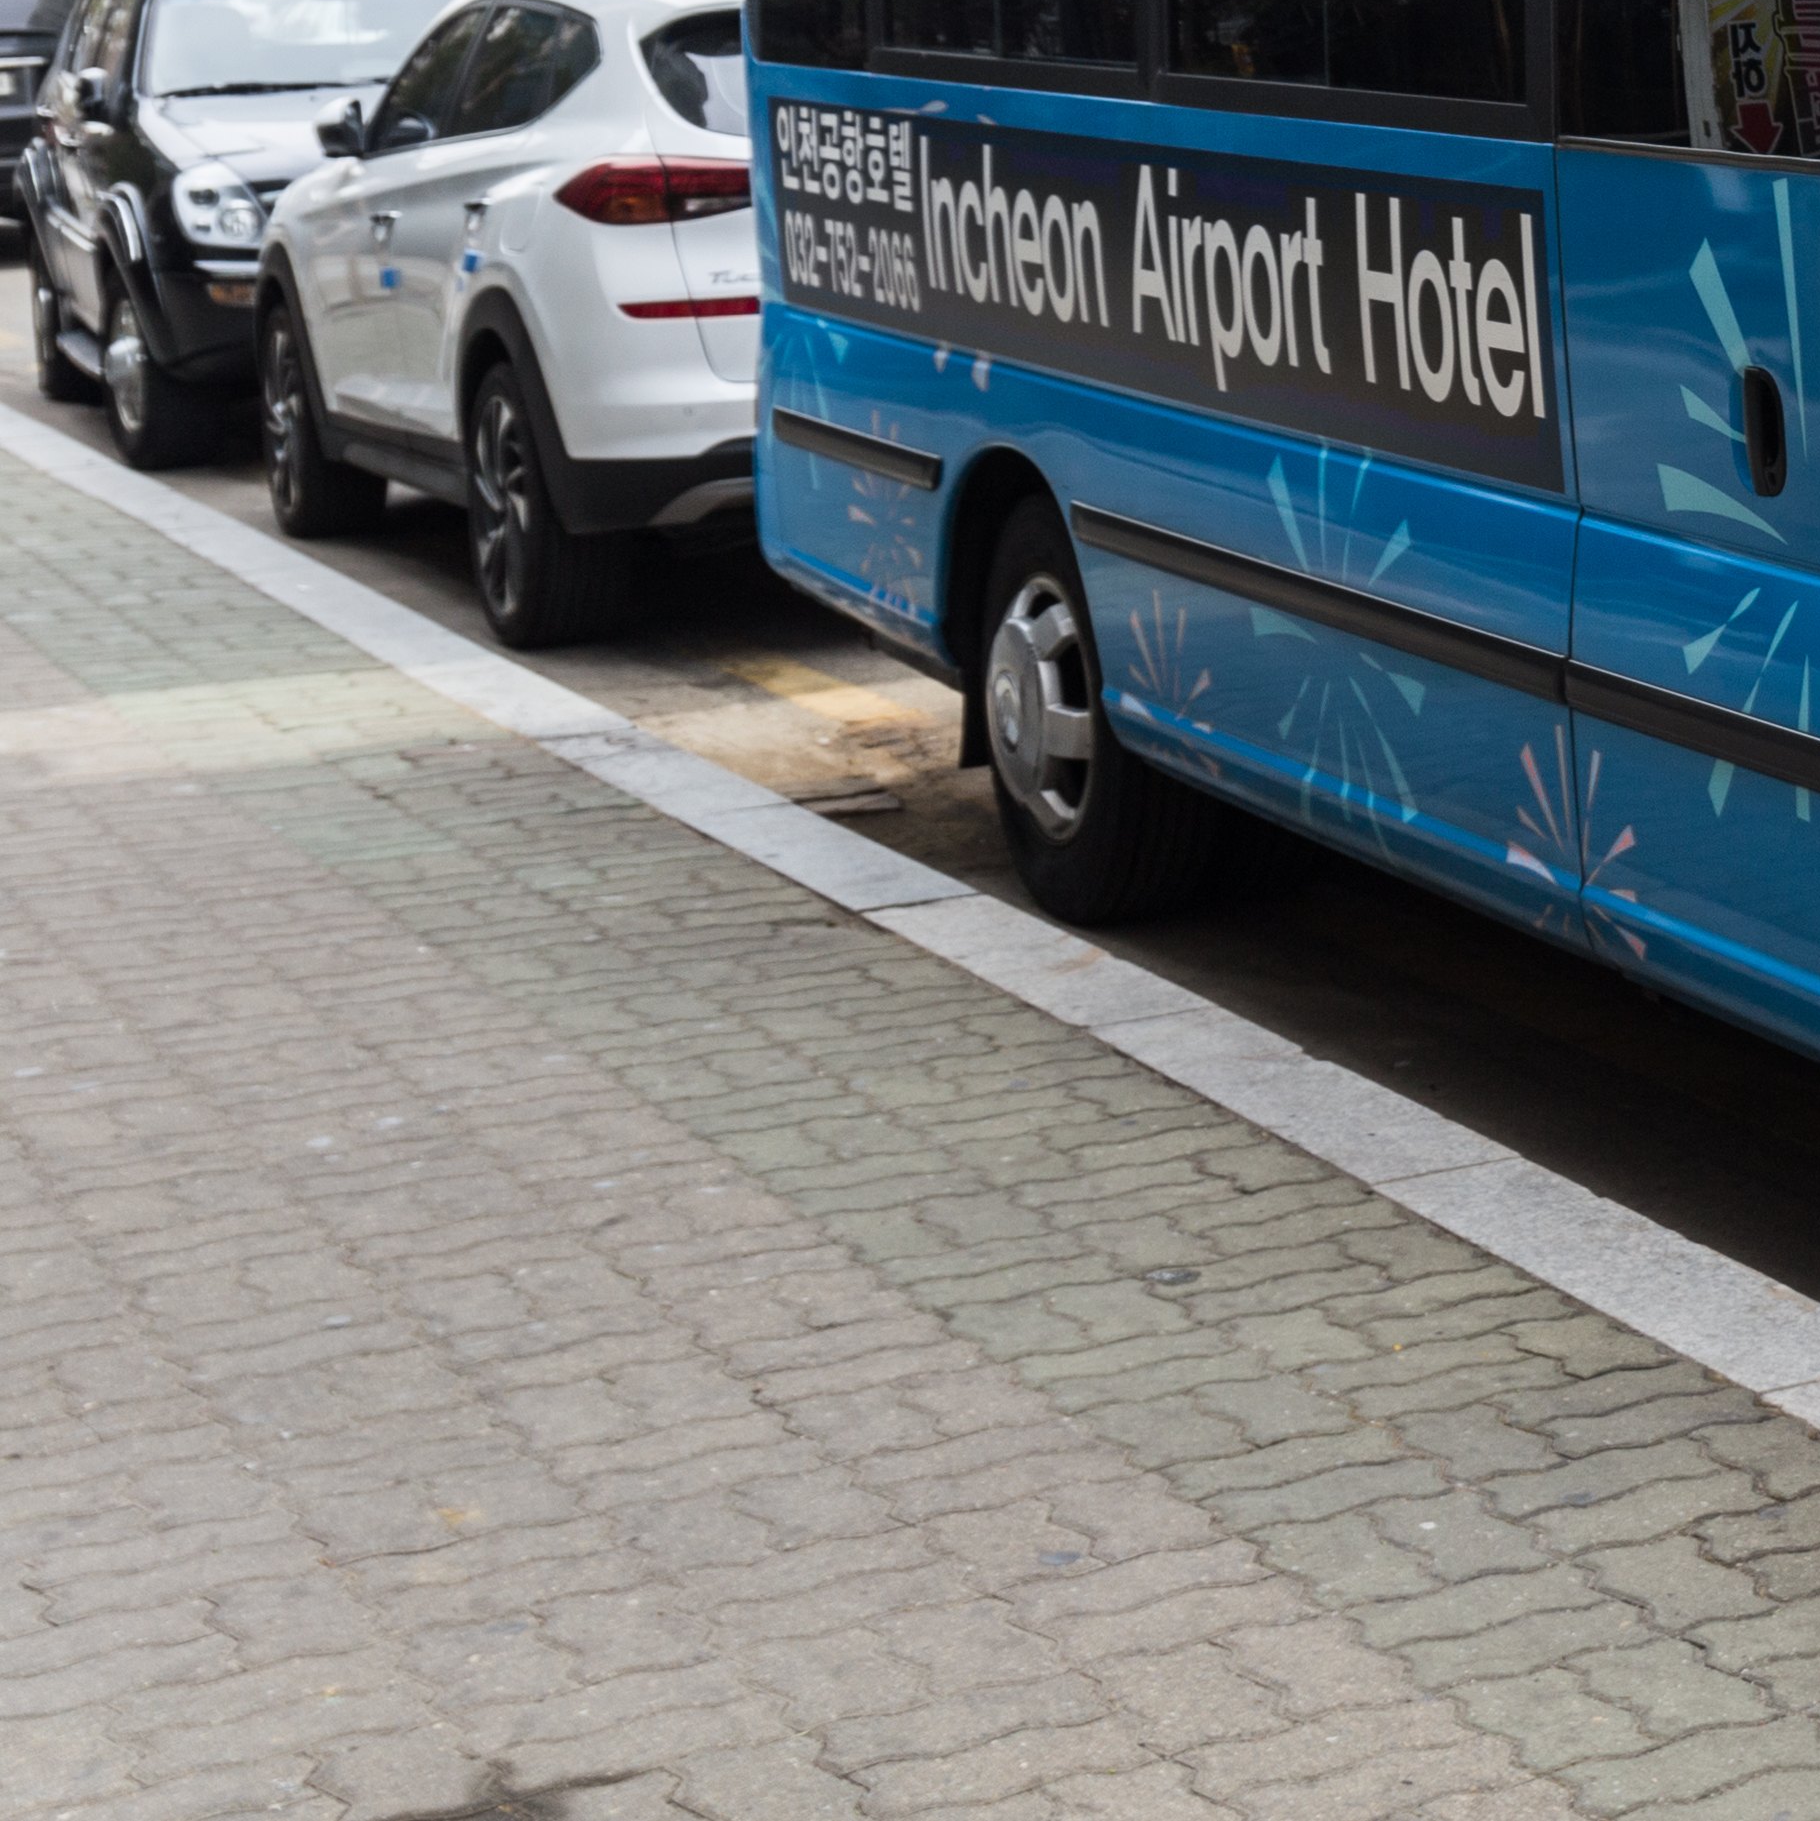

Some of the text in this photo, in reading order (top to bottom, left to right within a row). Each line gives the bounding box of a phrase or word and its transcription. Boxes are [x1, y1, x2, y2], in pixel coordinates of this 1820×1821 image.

[775, 104, 914, 213] 인천공항호텔
[783, 208, 921, 313] 032-752-2066
[919, 133, 1546, 420] Incheon Airport Hotel
